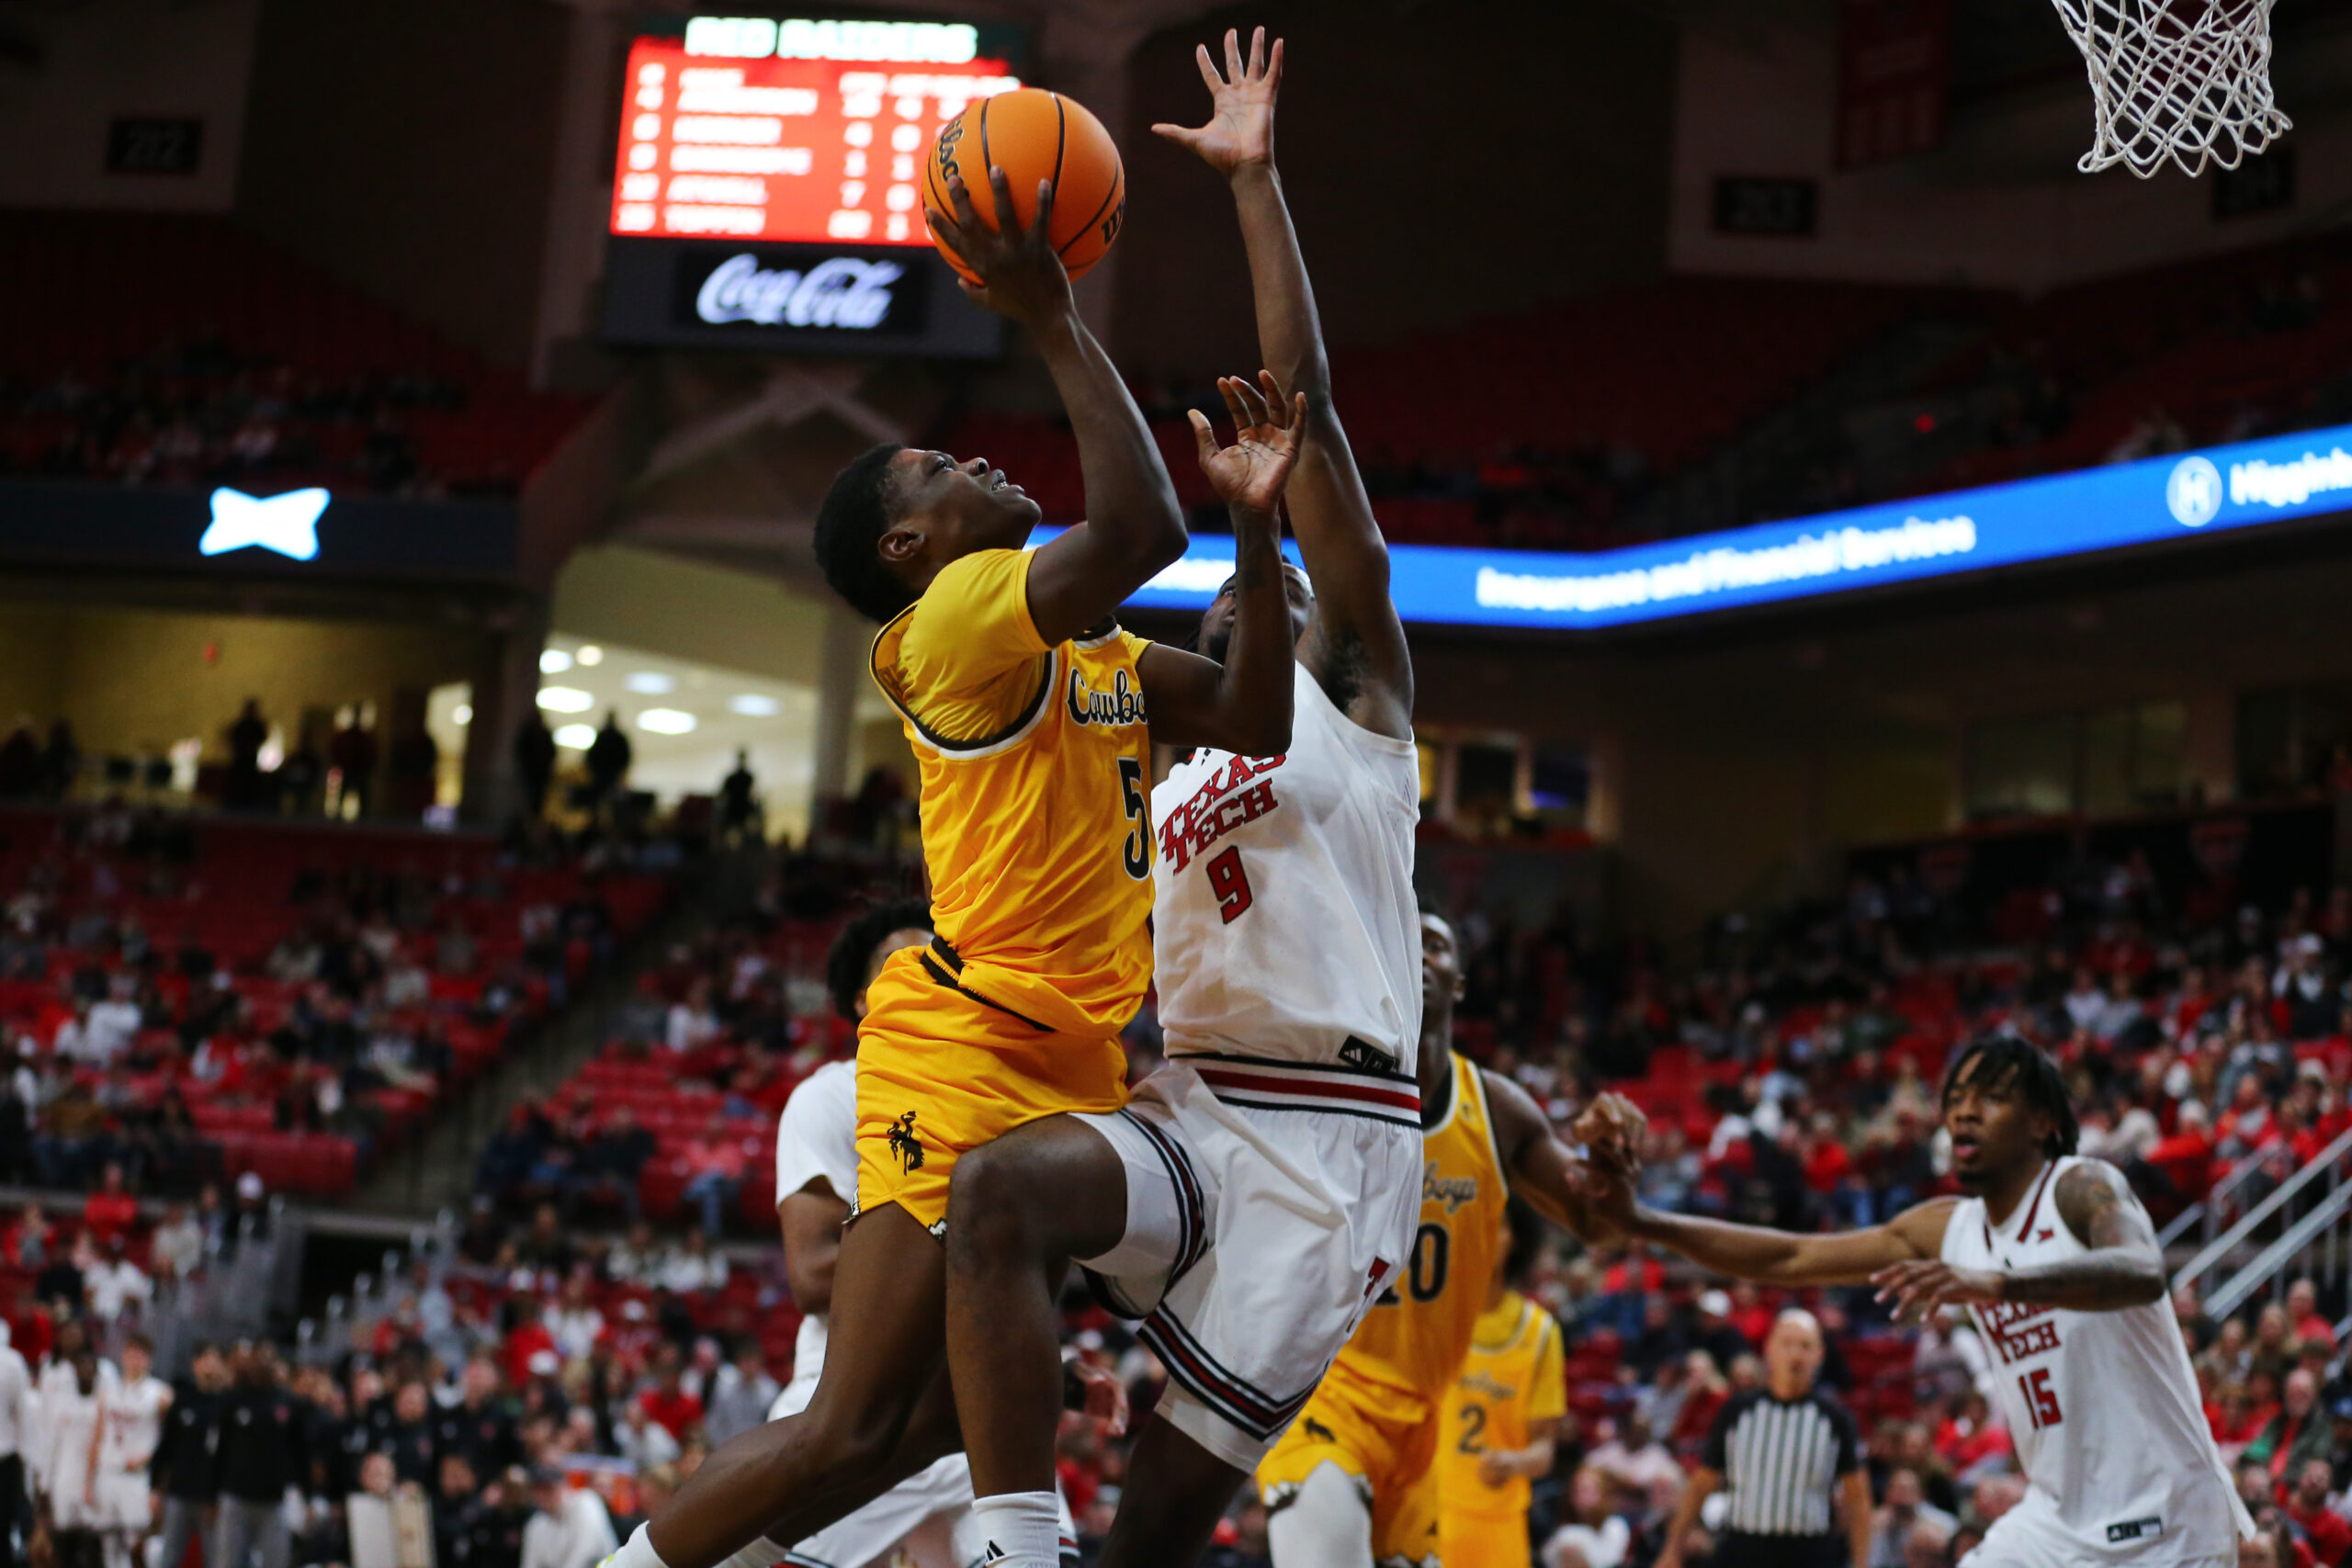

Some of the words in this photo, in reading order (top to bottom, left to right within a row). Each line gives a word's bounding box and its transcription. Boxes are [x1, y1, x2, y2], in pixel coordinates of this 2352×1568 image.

[1065, 667, 1148, 727] Cowbo
[1117, 756, 1150, 882] 5
[1159, 753, 1287, 854] TEXAS
[1165, 777, 1279, 877] TECH
[1205, 845, 1253, 924] 9
[1993, 1320, 2062, 1365] TECH
[1459, 1403, 1487, 1454] 2
[2018, 1367, 2063, 1430] 15
